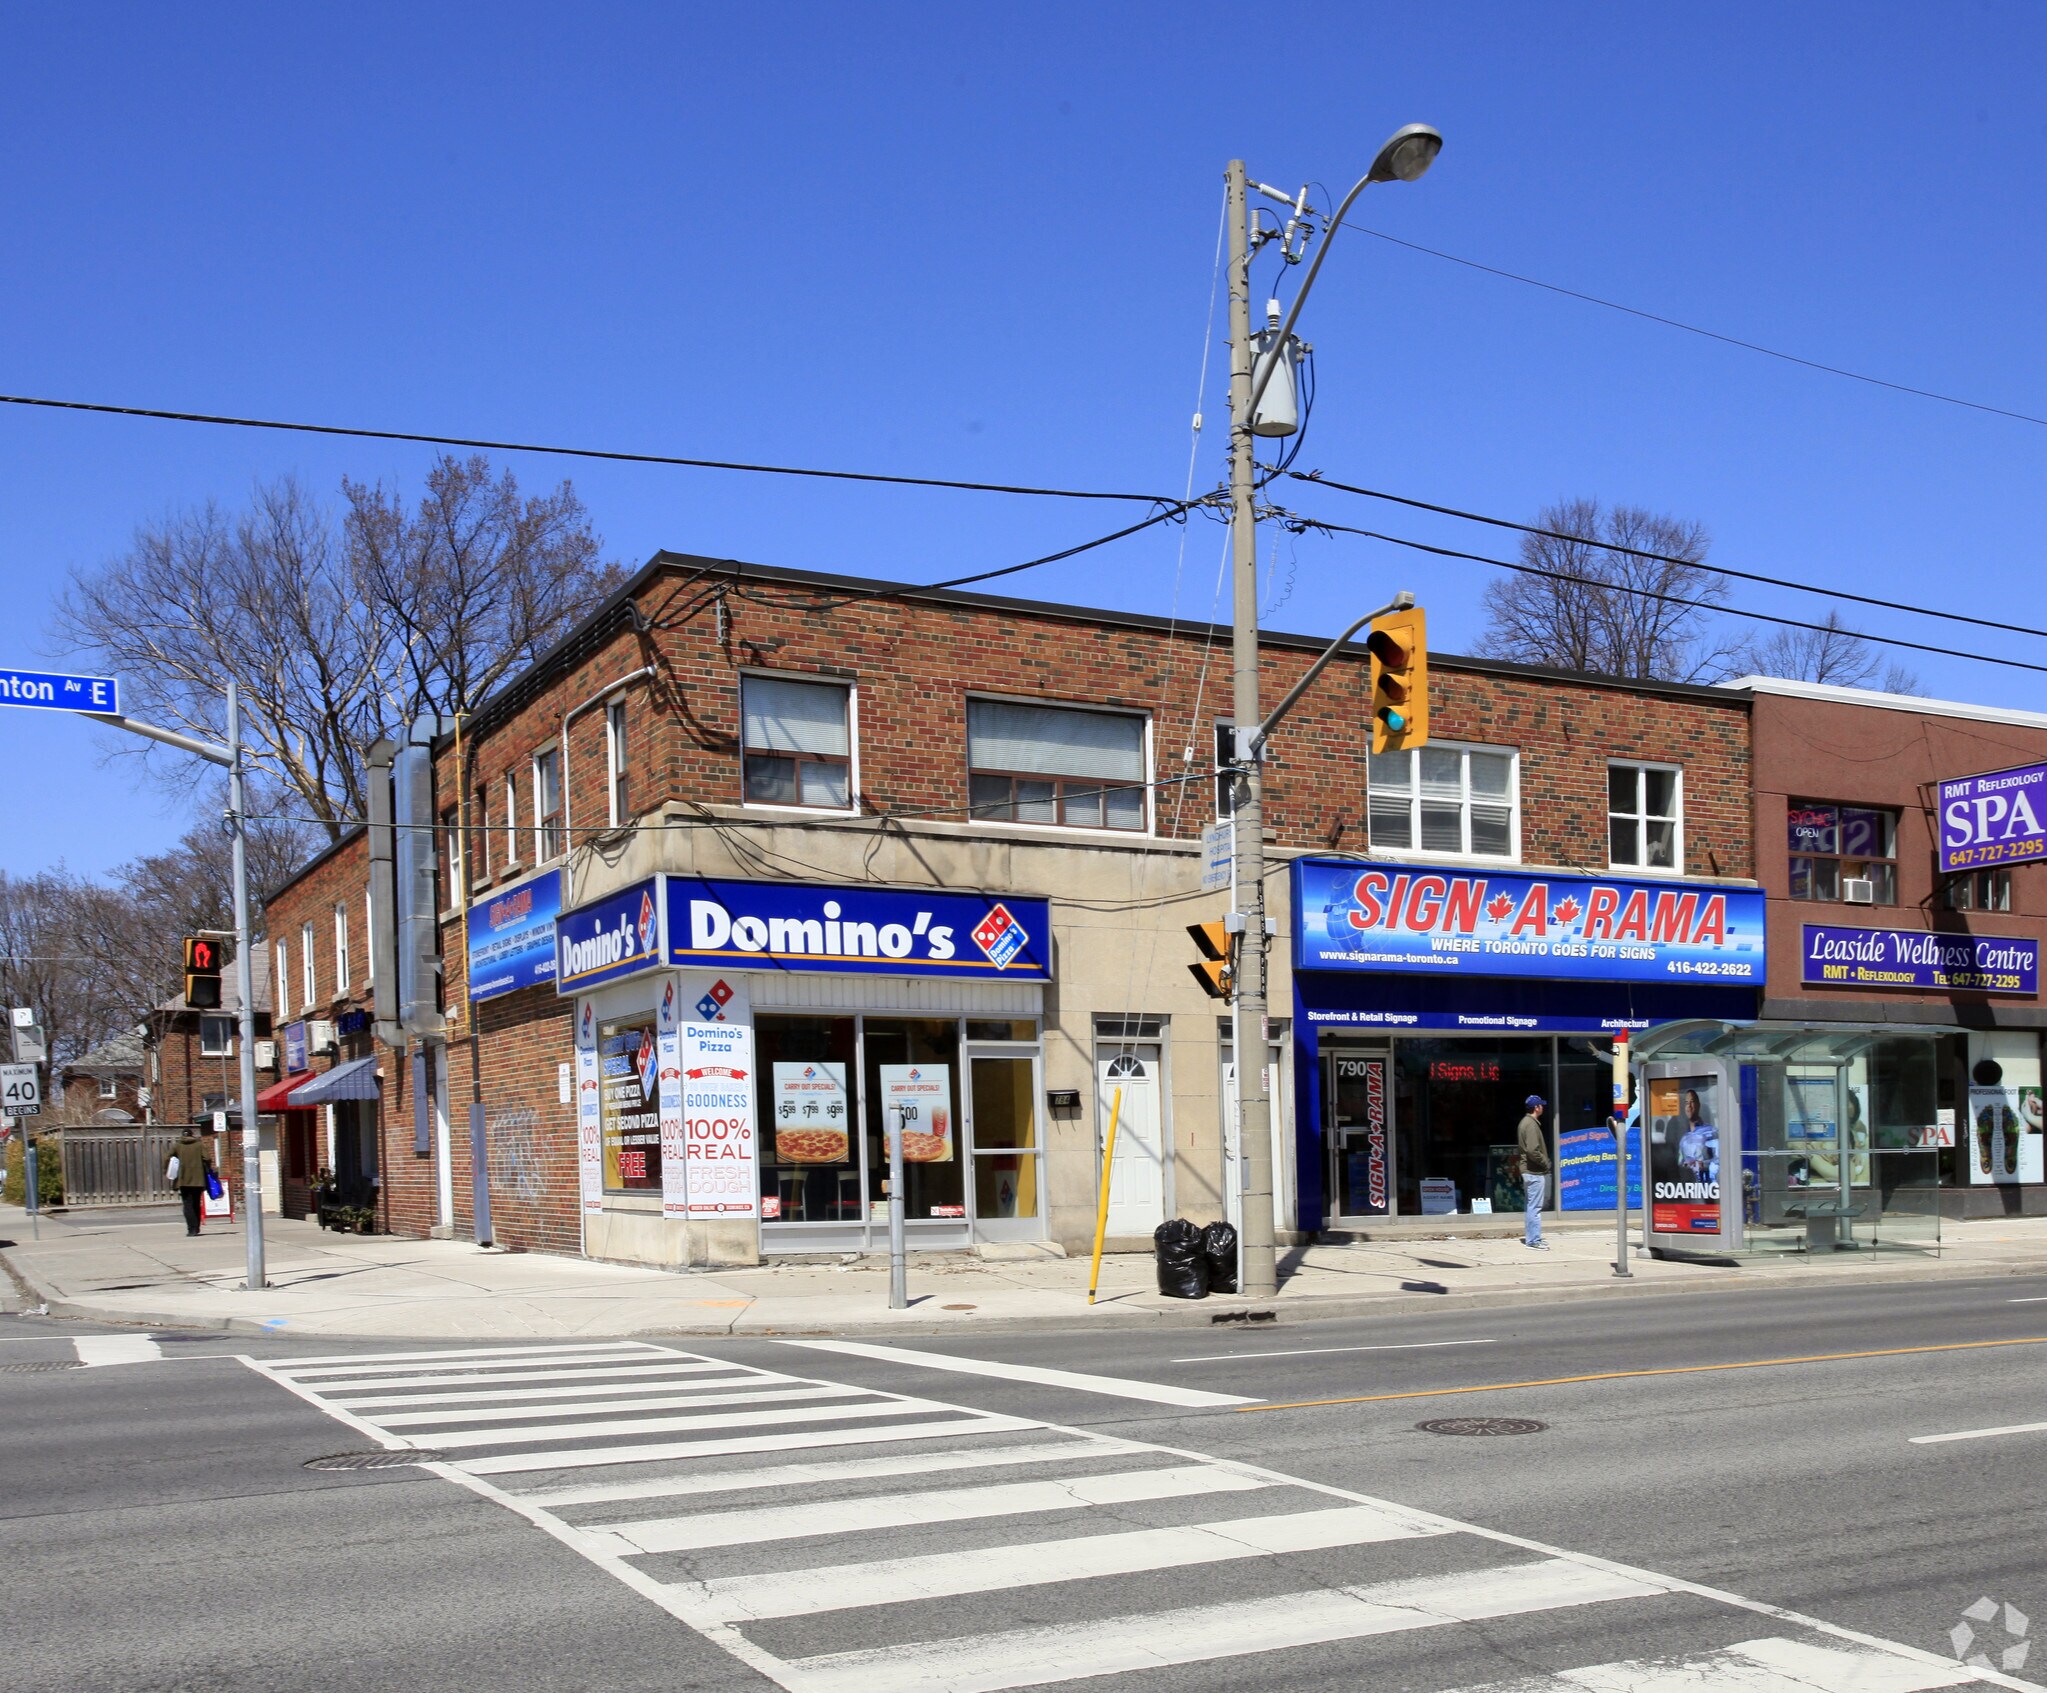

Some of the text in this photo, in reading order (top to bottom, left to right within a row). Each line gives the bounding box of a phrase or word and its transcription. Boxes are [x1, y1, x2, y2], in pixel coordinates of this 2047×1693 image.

[64, 679, 82, 693] Av
[92, 681, 107, 705] E
[1945, 771, 2045, 799] RMT REFLEXOLOGY
[1945, 790, 2046, 847] SPA
[1796, 827, 1819, 838] OPEN
[1949, 838, 2044, 866] 647-727-2295
[1347, 870, 1727, 947] SIGN A RAMA
[690, 899, 956, 961] Domino's
[561, 912, 635, 977] Domino's
[990, 927, 1018, 959] Domino's
[1431, 937, 1656, 961] WHERE TORONTO GOES FOR SIGNS
[1810, 932, 2034, 971] Leaside Wellness Centre
[996, 945, 1016, 965] Pizza
[1319, 949, 1459, 966] www.signarama-toronto.ca
[1667, 960, 1752, 977] 416-422-2622
[1823, 964, 1849, 979] RMT
[1857, 966, 1915, 983] REFLEXOLOGY
[1952, 972, 2021, 989] 647-727-2295
[1308, 1011, 1418, 1026] Storefront & Retail Signage
[1458, 1015, 1538, 1028] Promotional Signage
[1601, 1018, 1649, 1029] Architectural
[687, 1026, 743, 1040] Domino's
[699, 1040, 732, 1052] Pizza
[2, 1067, 33, 1076] MAXIMUM
[700, 1066, 733, 1077] WELCOME
[1337, 1061, 1367, 1076] 790
[5, 1081, 36, 1102] 40
[687, 1094, 747, 1108] GOODNESS
[7, 1105, 38, 1116] BEGINS
[617, 1115, 640, 1130] SECOND
[640, 1113, 659, 1128] PIZZA
[685, 1118, 751, 1140] 100%
[1366, 1062, 1386, 1209] SIGN A RAMA
[1588, 1131, 1609, 1141] Signs
[1907, 1127, 1952, 1146] SPA
[663, 1144, 684, 1160] REAL
[686, 1143, 752, 1160] REAL
[617, 1151, 646, 1178] FREE
[689, 1165, 751, 1180] FRESH
[689, 1180, 751, 1194] DOUGH
[1655, 1181, 1720, 1199] SOARING
